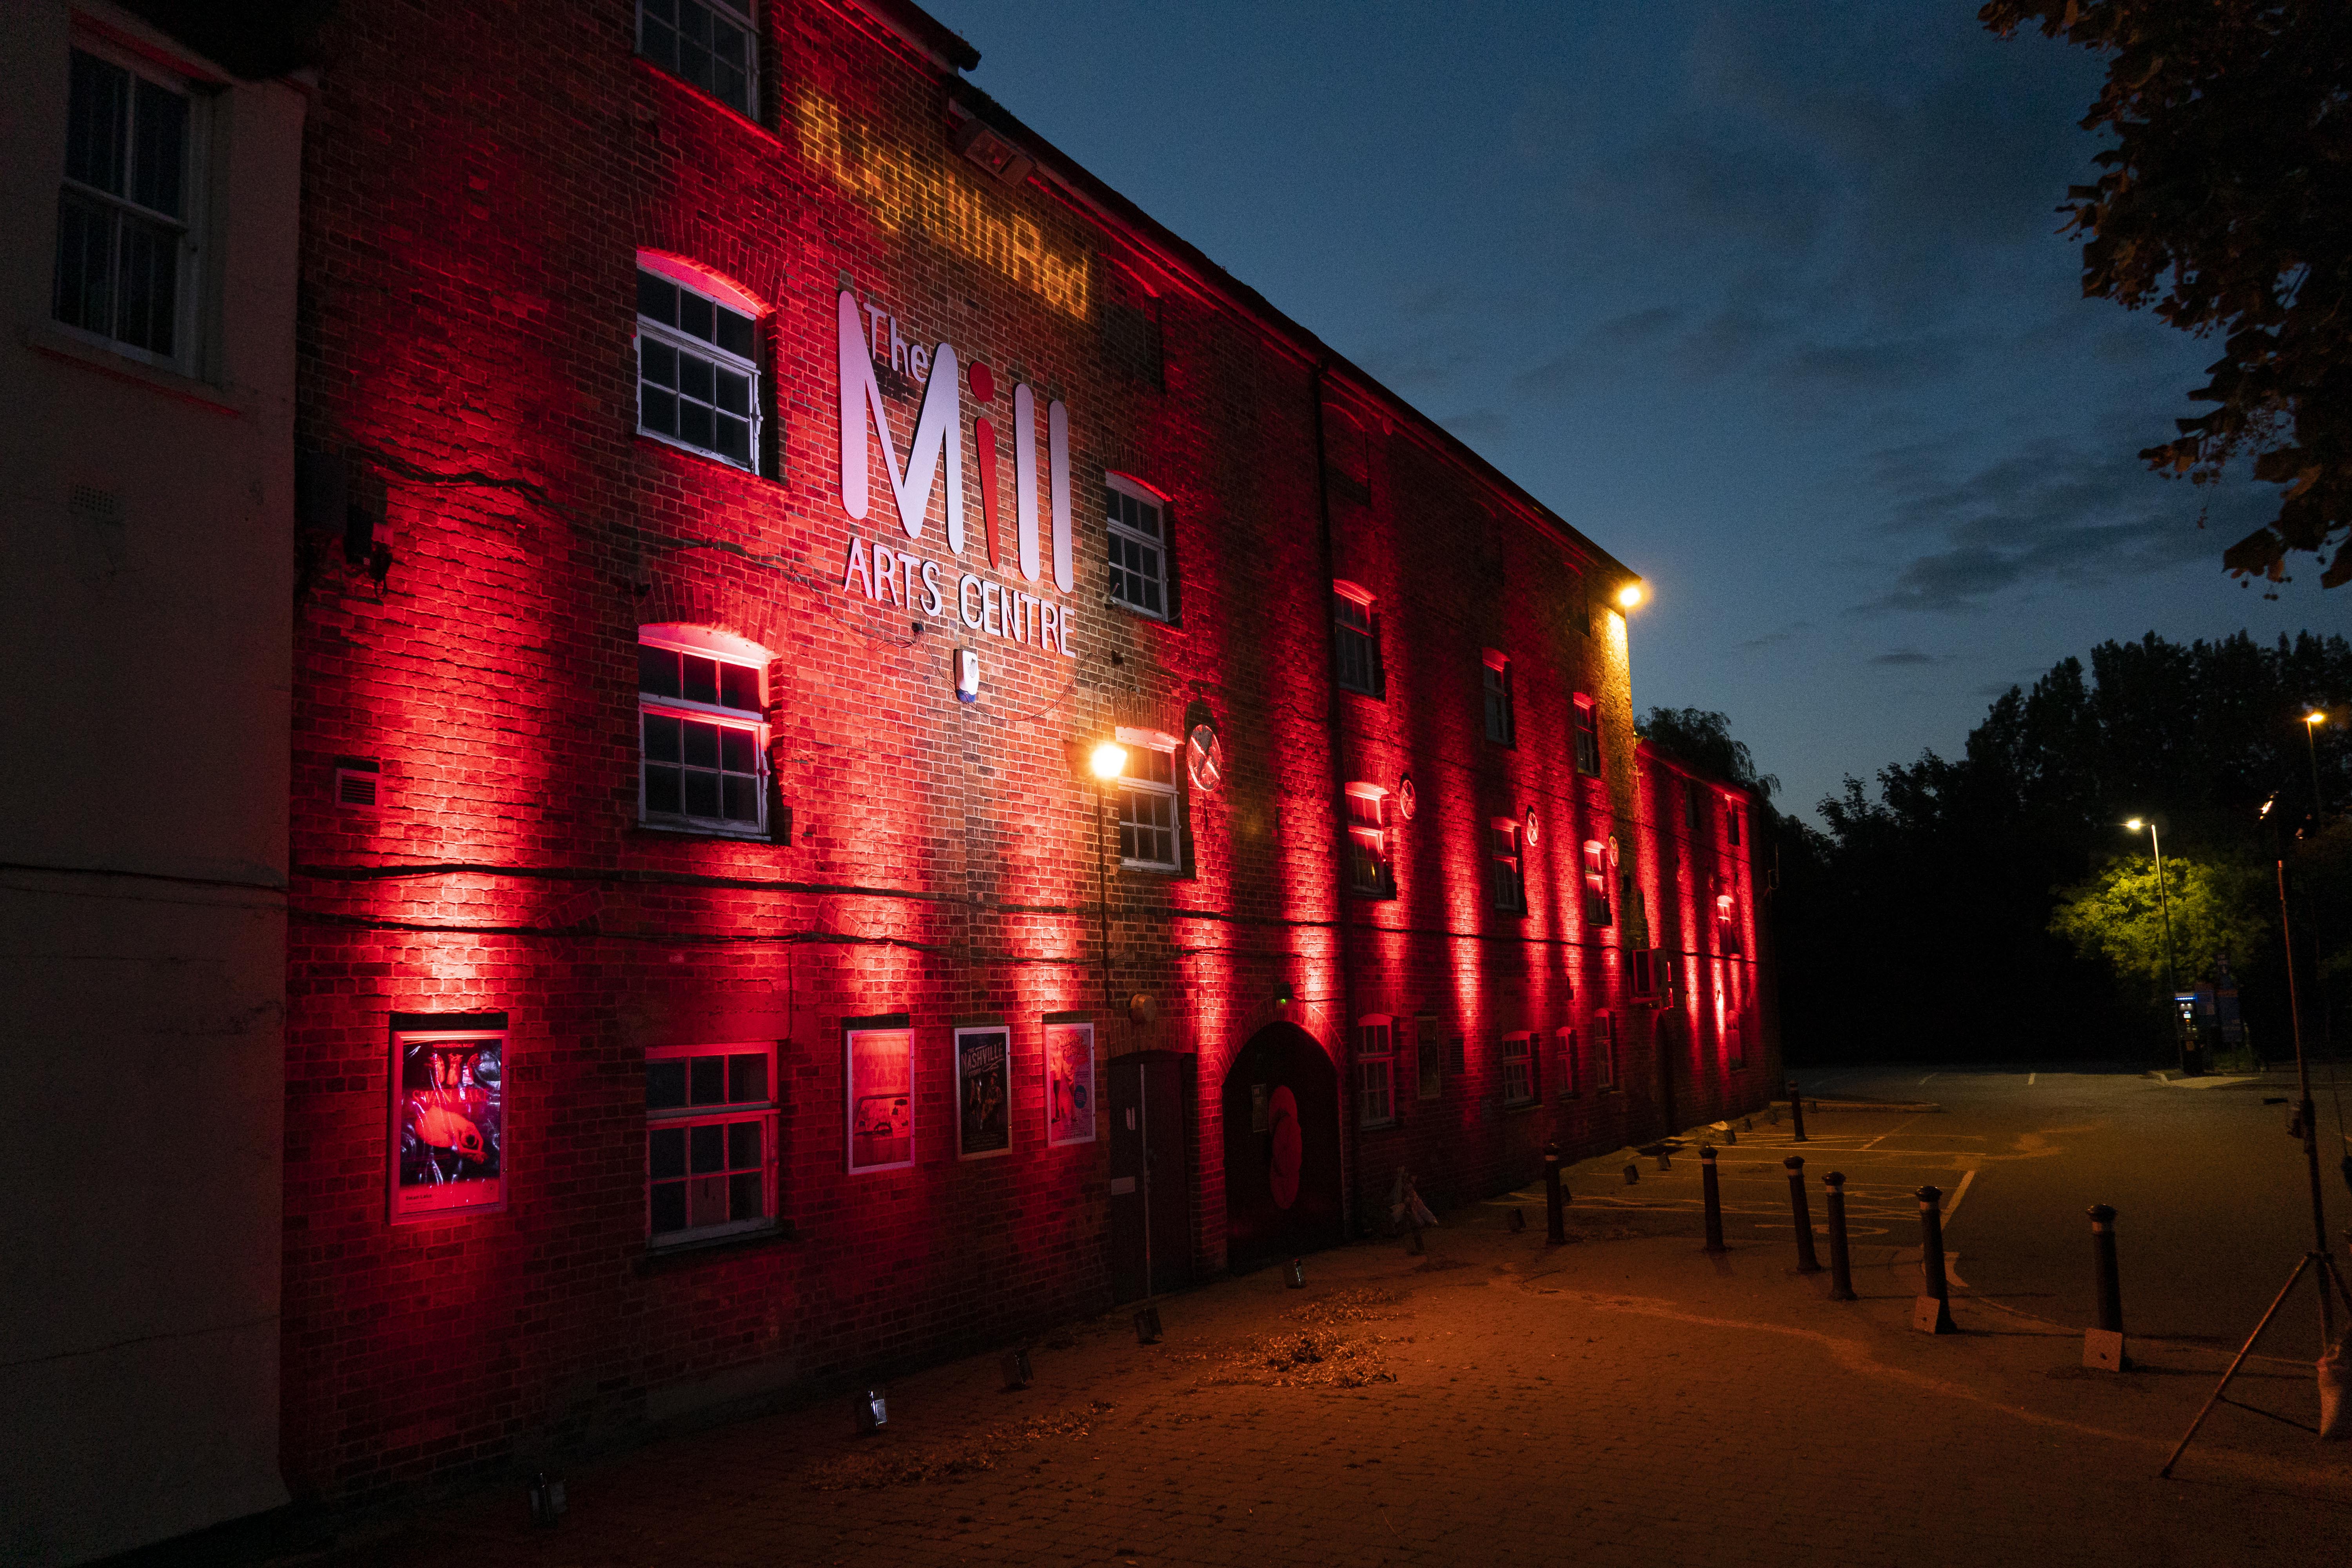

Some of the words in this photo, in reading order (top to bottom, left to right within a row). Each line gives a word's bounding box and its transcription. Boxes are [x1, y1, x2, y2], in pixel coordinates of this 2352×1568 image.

[863, 302, 928, 383] The
[839, 290, 1073, 594] Mill
[844, 537, 942, 617] ARTS
[960, 574, 1076, 659] CENTRE
[960, 1042, 1004, 1078] NASHVILLE
[968, 1067, 981, 1078] STORY
[413, 1089, 452, 1104] SWAN
